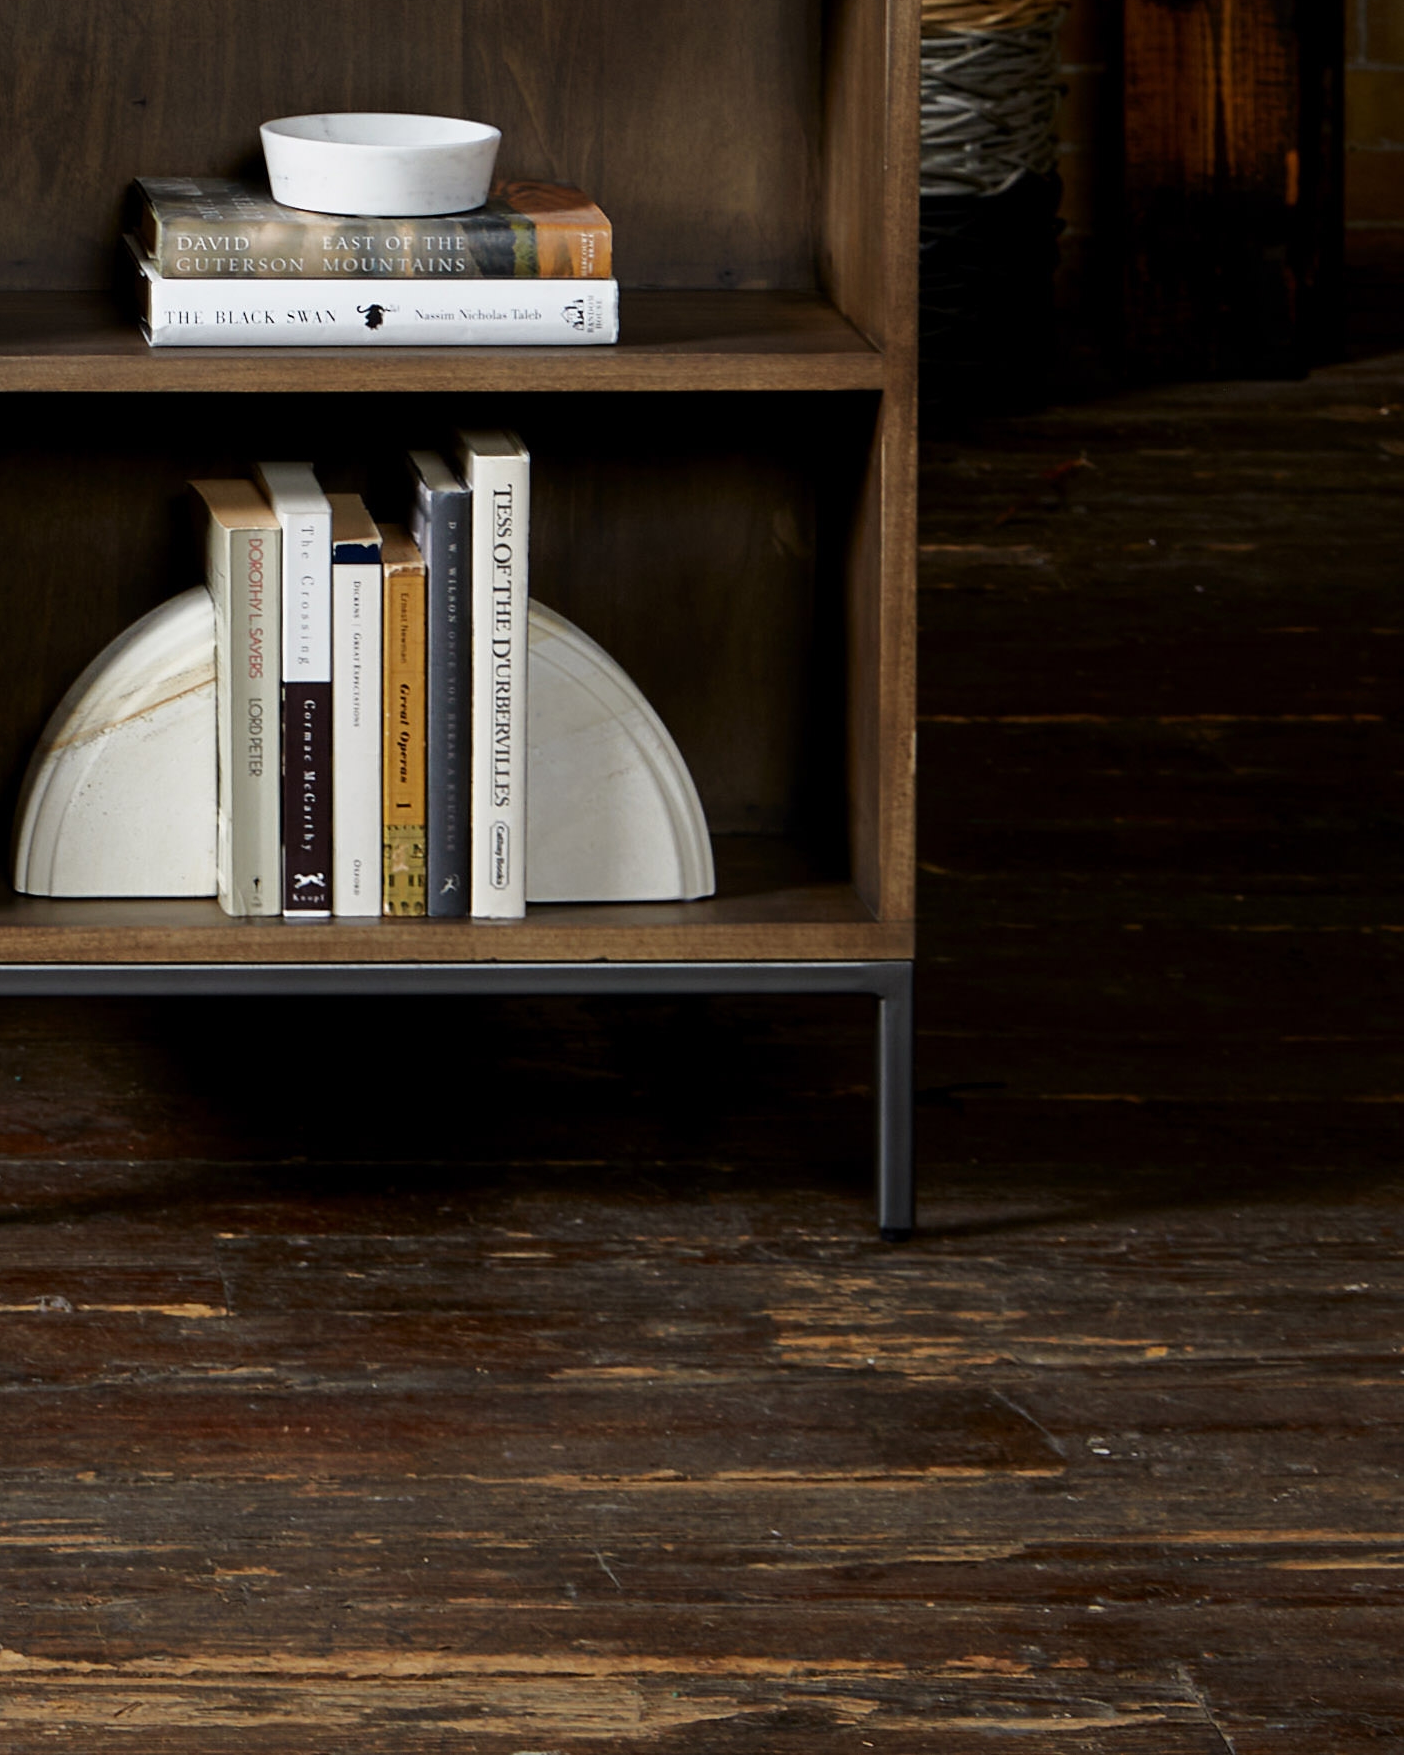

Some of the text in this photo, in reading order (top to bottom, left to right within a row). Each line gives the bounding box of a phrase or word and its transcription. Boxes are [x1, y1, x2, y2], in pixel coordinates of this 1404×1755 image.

[176, 235, 250, 252] DAVID
[176, 256, 304, 273] GUTERSON
[322, 236, 466, 252] EAST OF THE
[322, 256, 466, 272] MOUNTAINS
[164, 309, 337, 324] THE BLACK SWAN
[415, 308, 542, 321] Nassim Nicholas Taleb
[248, 538, 264, 611] DOROTHY
[297, 525, 315, 665] The Crossing
[447, 566, 457, 624] WILSON
[248, 627, 264, 680] SAYERS
[399, 592, 409, 664] Ernest Newman
[447, 631, 457, 667] ONCE
[492, 483, 513, 808] TESS OF THE D'URBERVILLES
[248, 698, 264, 778] LORD PETER
[396, 683, 411, 784] Great Operas
[447, 713, 457, 760] BREAK
[300, 699, 317, 852] Cormac McCarthy
